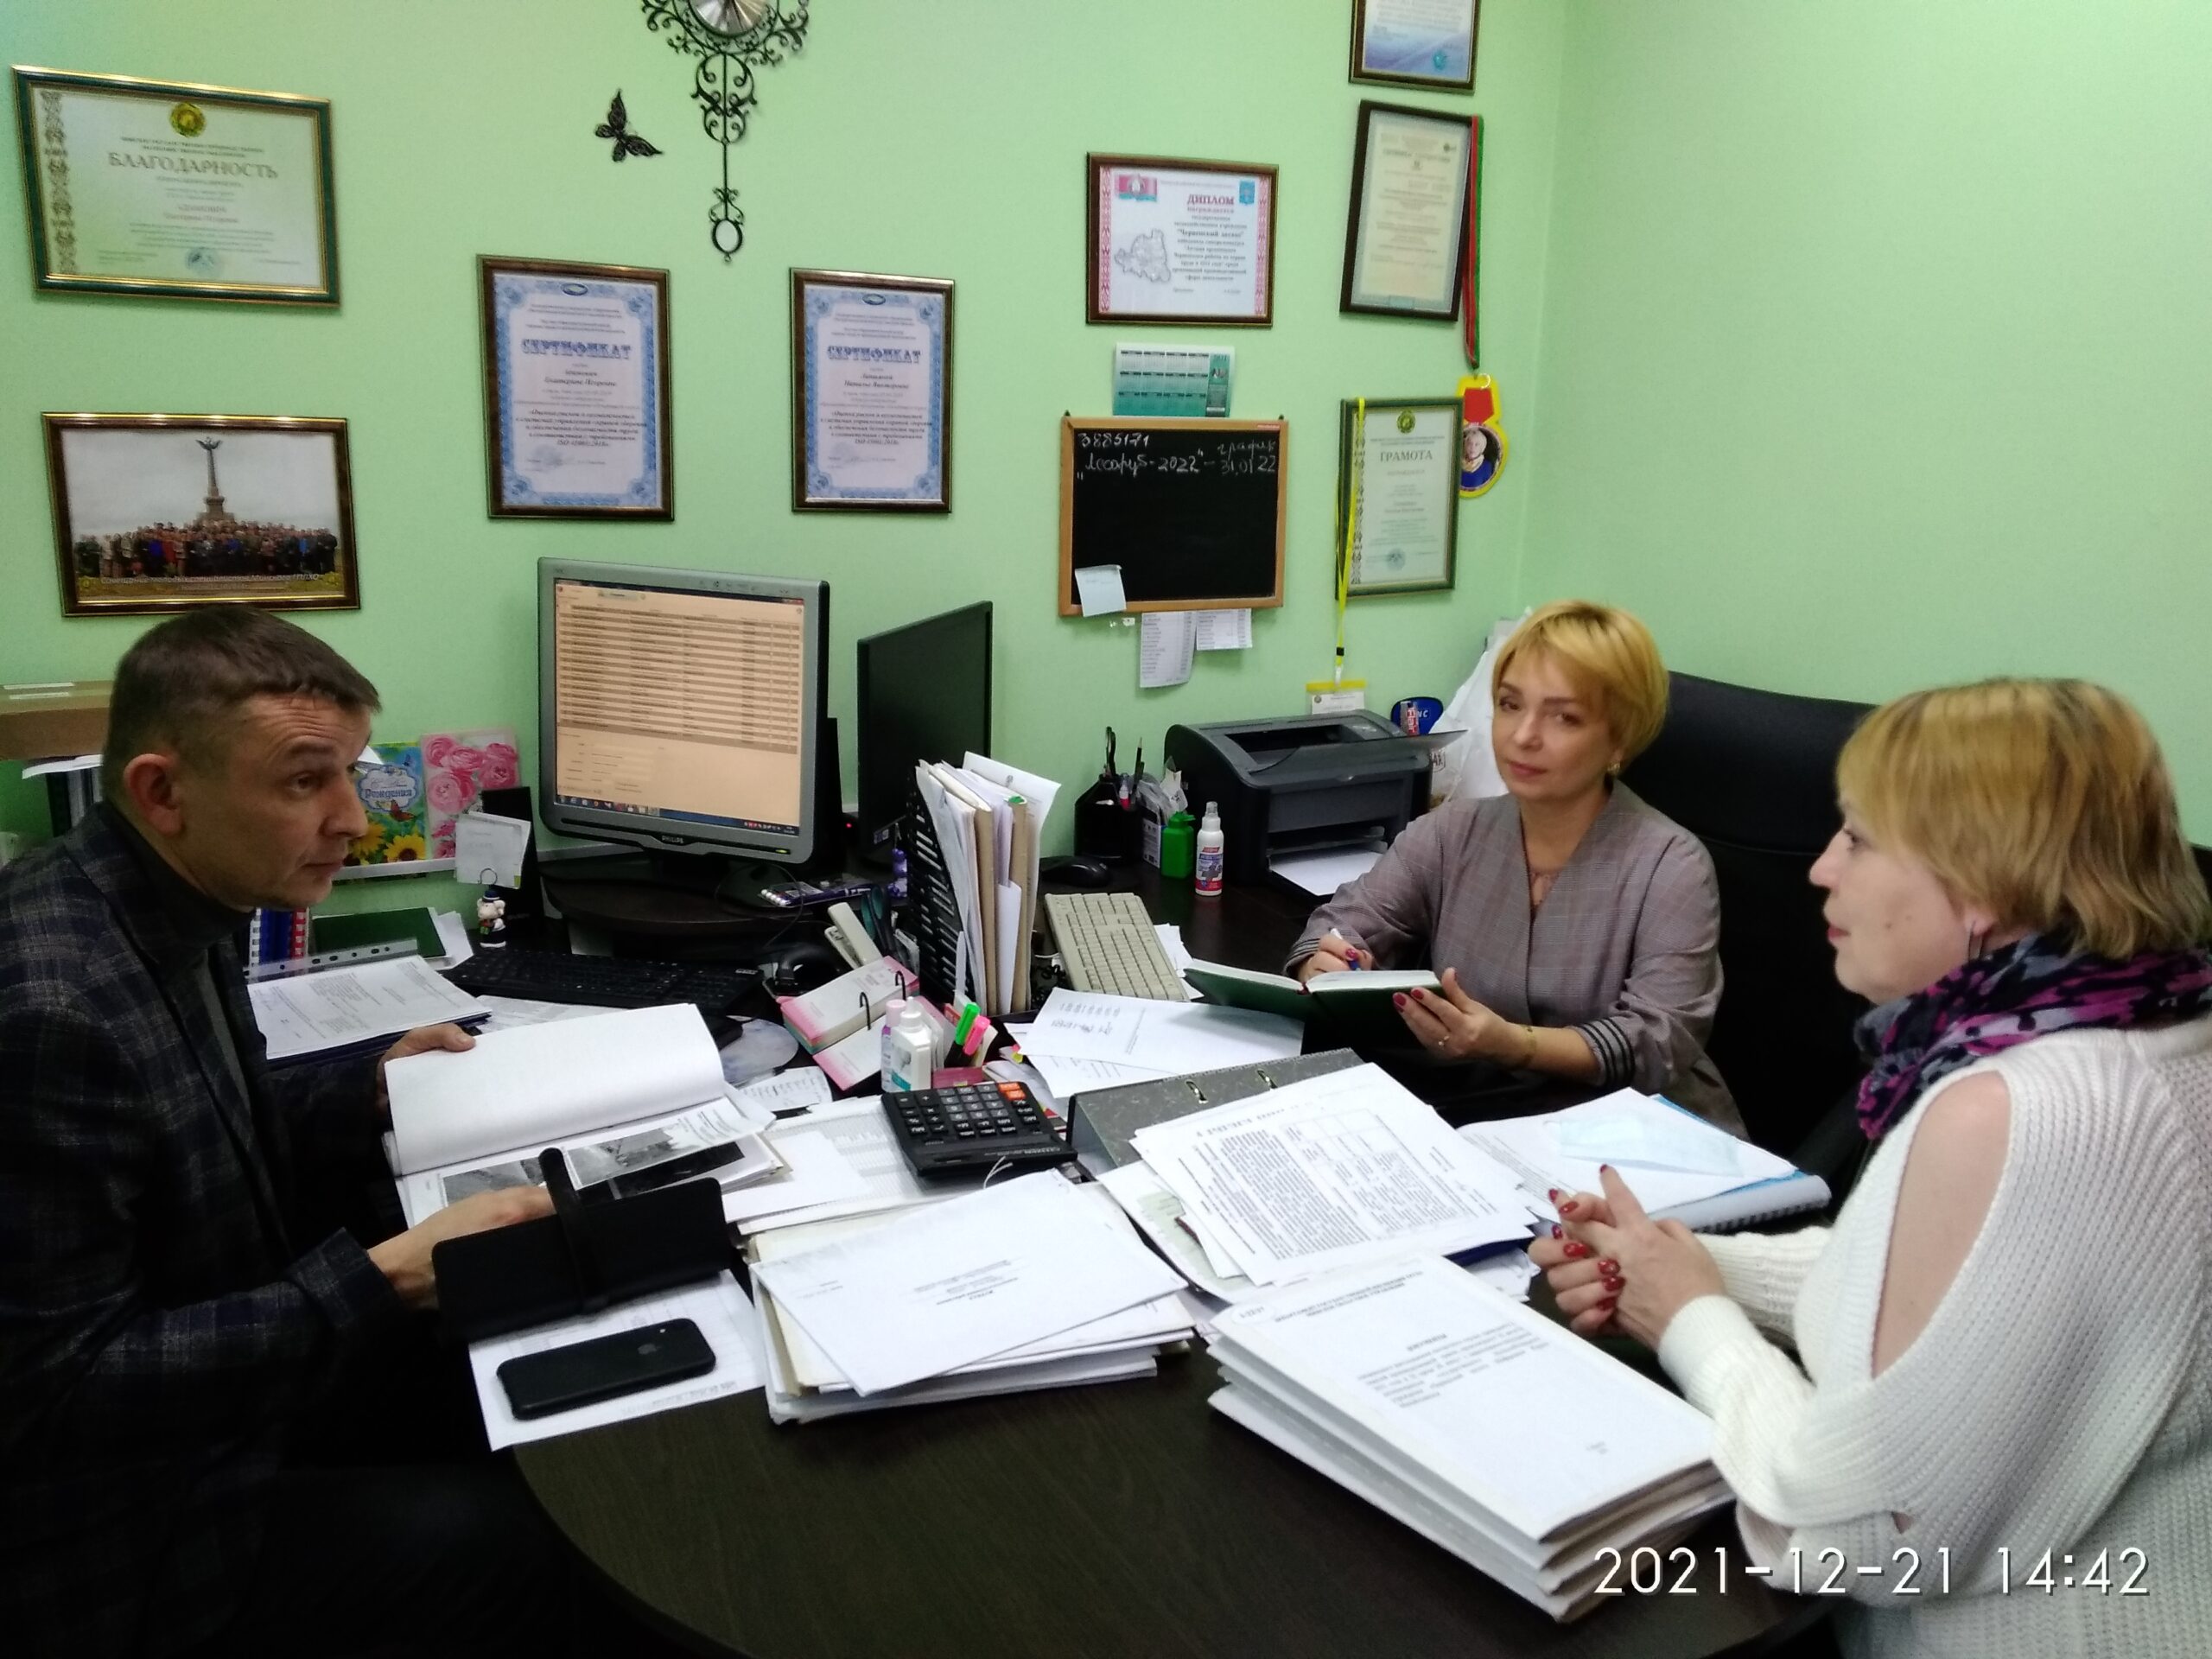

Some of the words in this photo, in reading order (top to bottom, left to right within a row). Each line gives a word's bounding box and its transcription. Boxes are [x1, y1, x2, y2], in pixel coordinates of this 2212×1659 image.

[108, 152, 278, 179] БЛАГОДАРНОСТЬ
[1187, 194, 1234, 205] ДИПЛОМ
[523, 339, 631, 359] СЕРТИФИКАТ
[827, 346, 921, 364] СЕРТИФИКАТ
[1380, 450, 1433, 462] ГРАМОТА
